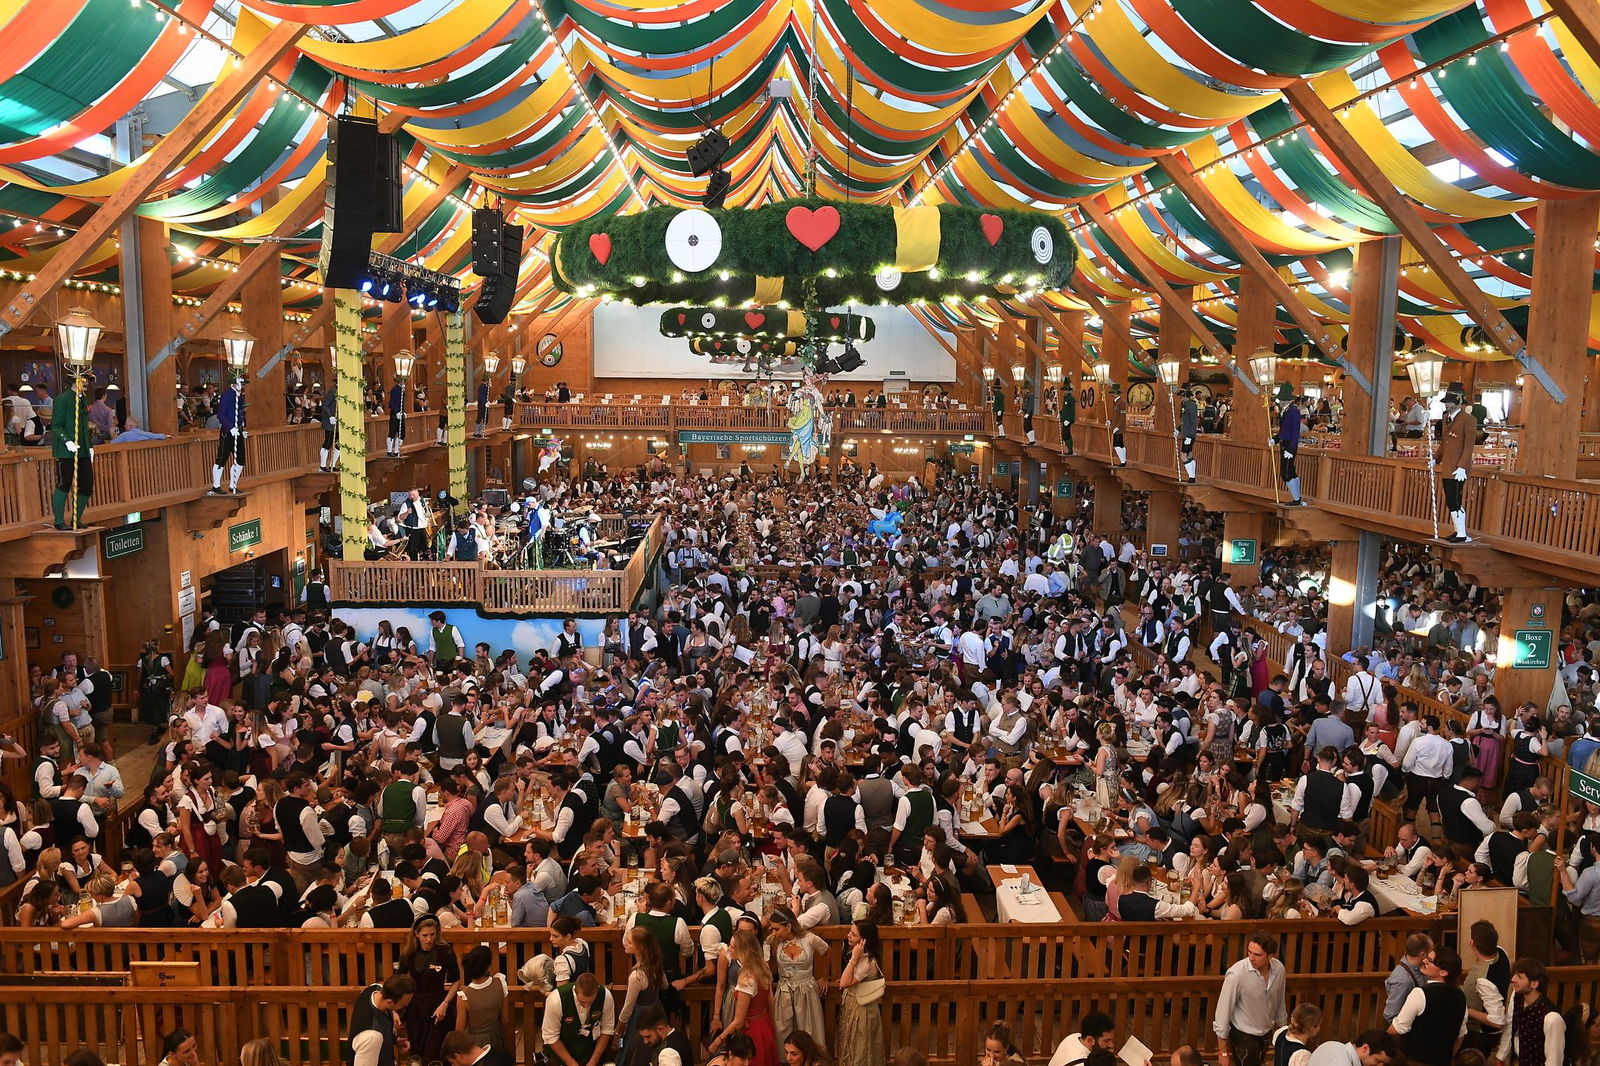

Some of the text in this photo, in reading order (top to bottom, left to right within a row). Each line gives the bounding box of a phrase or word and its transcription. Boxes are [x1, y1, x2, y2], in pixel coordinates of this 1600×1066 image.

[691, 433, 733, 442] Bayerische
[1062, 486, 1067, 494] 4
[232, 530, 254, 545] Schänke
[109, 538, 140, 552] Toiletten
[1240, 547, 1246, 558] 3
[1525, 633, 1542, 641] Boxe
[1526, 643, 1537, 658] 2
